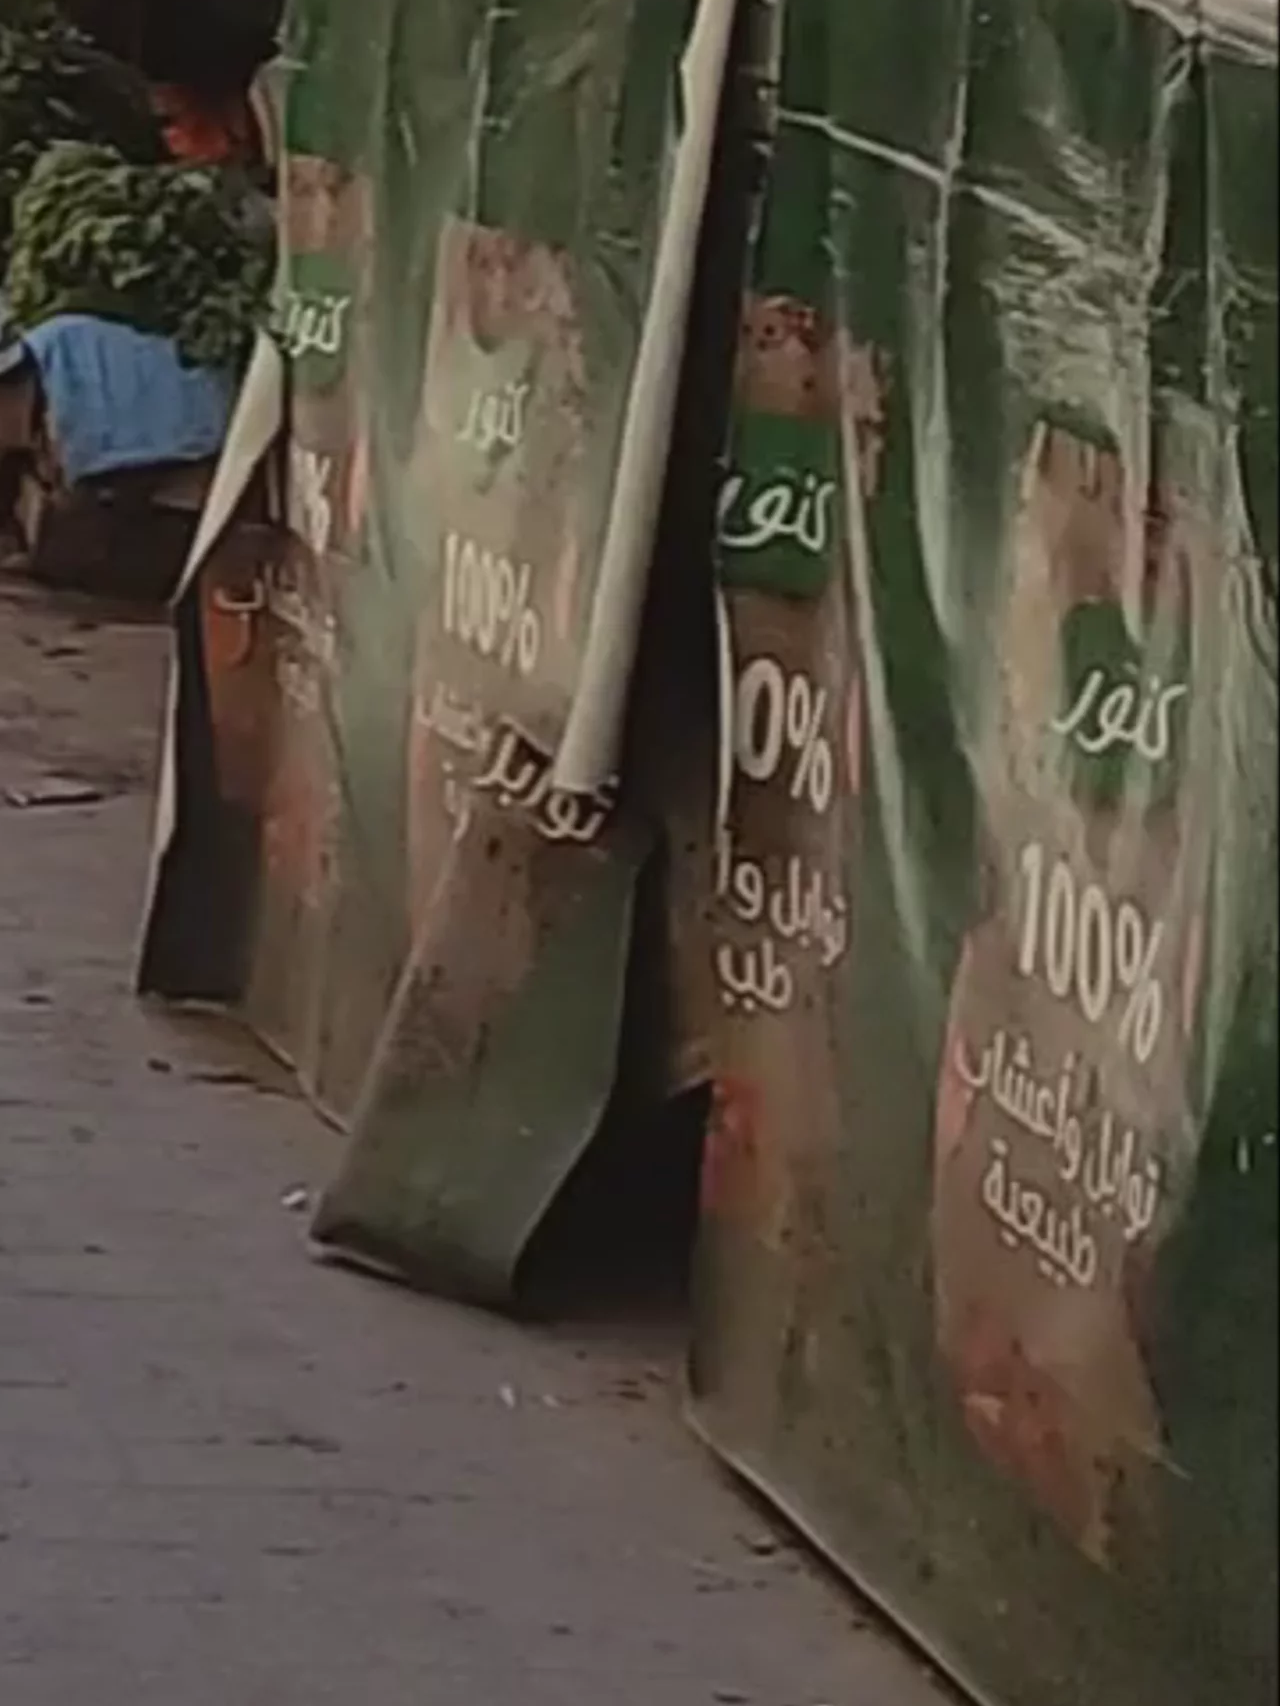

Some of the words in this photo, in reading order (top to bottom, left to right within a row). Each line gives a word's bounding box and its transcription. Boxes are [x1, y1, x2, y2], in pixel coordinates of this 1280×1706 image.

[445, 531, 539, 675] 100%
[1052, 663, 1187, 760] كنور
[1018, 842, 1163, 1063] 100%
[982, 1138, 1096, 1286] طبيعية
[1083, 1110, 1160, 1241] توابل
